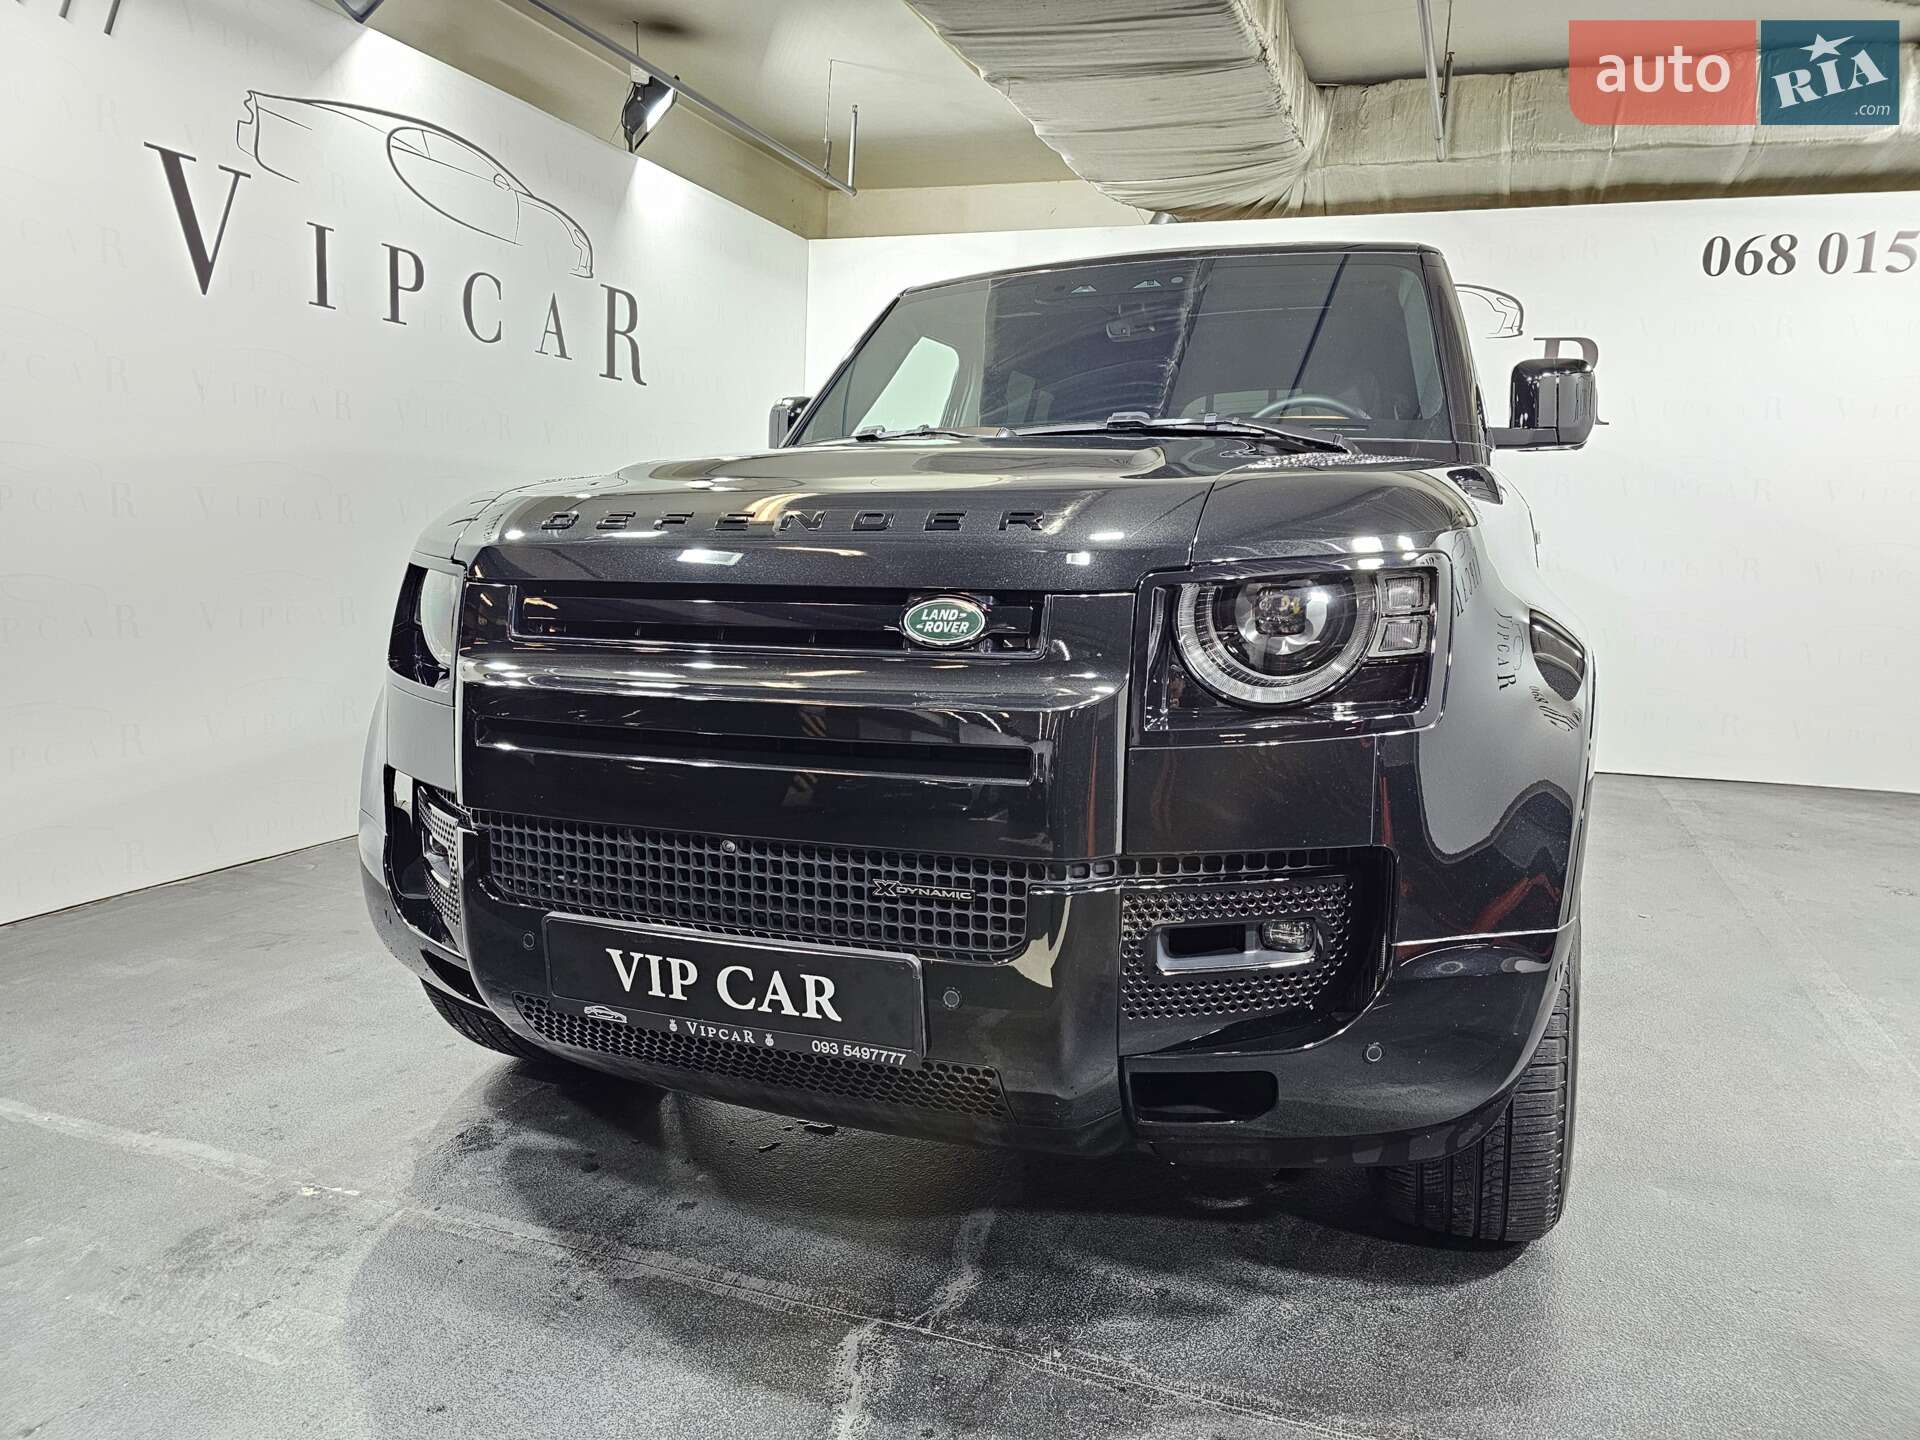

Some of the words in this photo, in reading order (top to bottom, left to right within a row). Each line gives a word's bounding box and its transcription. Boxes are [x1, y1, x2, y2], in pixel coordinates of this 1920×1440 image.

[144, 141, 647, 386] VIPCAR
[1702, 234, 1798, 277] 068
[1818, 230, 1920, 275] 015
[541, 511, 1044, 532] DEFENDER
[605, 948, 698, 1001] VIP
[717, 965, 842, 1022] CAR
[686, 1021, 755, 1044] VIPCAR
[811, 1039, 839, 1055] 093
[843, 1044, 906, 1066] 5497777
